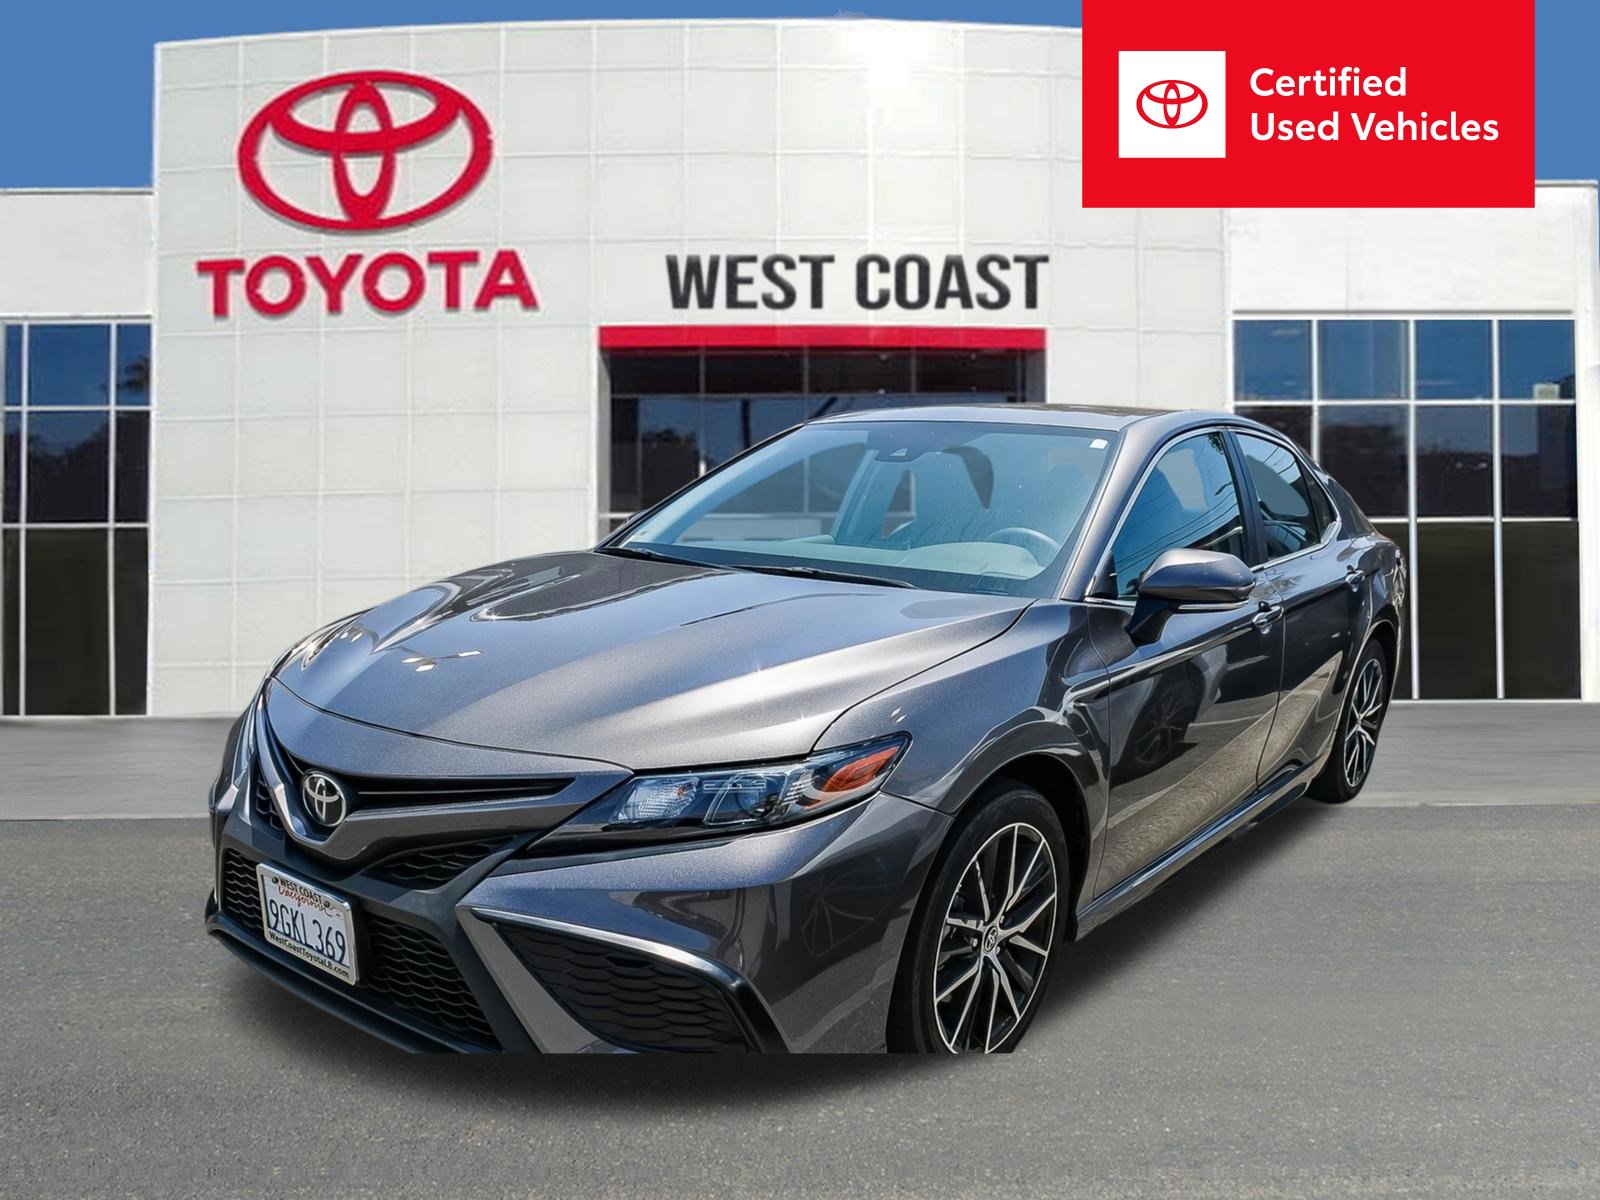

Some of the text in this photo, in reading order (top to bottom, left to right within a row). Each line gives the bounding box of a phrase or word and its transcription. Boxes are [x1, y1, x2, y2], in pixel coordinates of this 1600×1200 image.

[196, 249, 539, 317] TOYOTA
[666, 254, 1049, 310] WEST COAST
[298, 886, 322, 904] COAST
